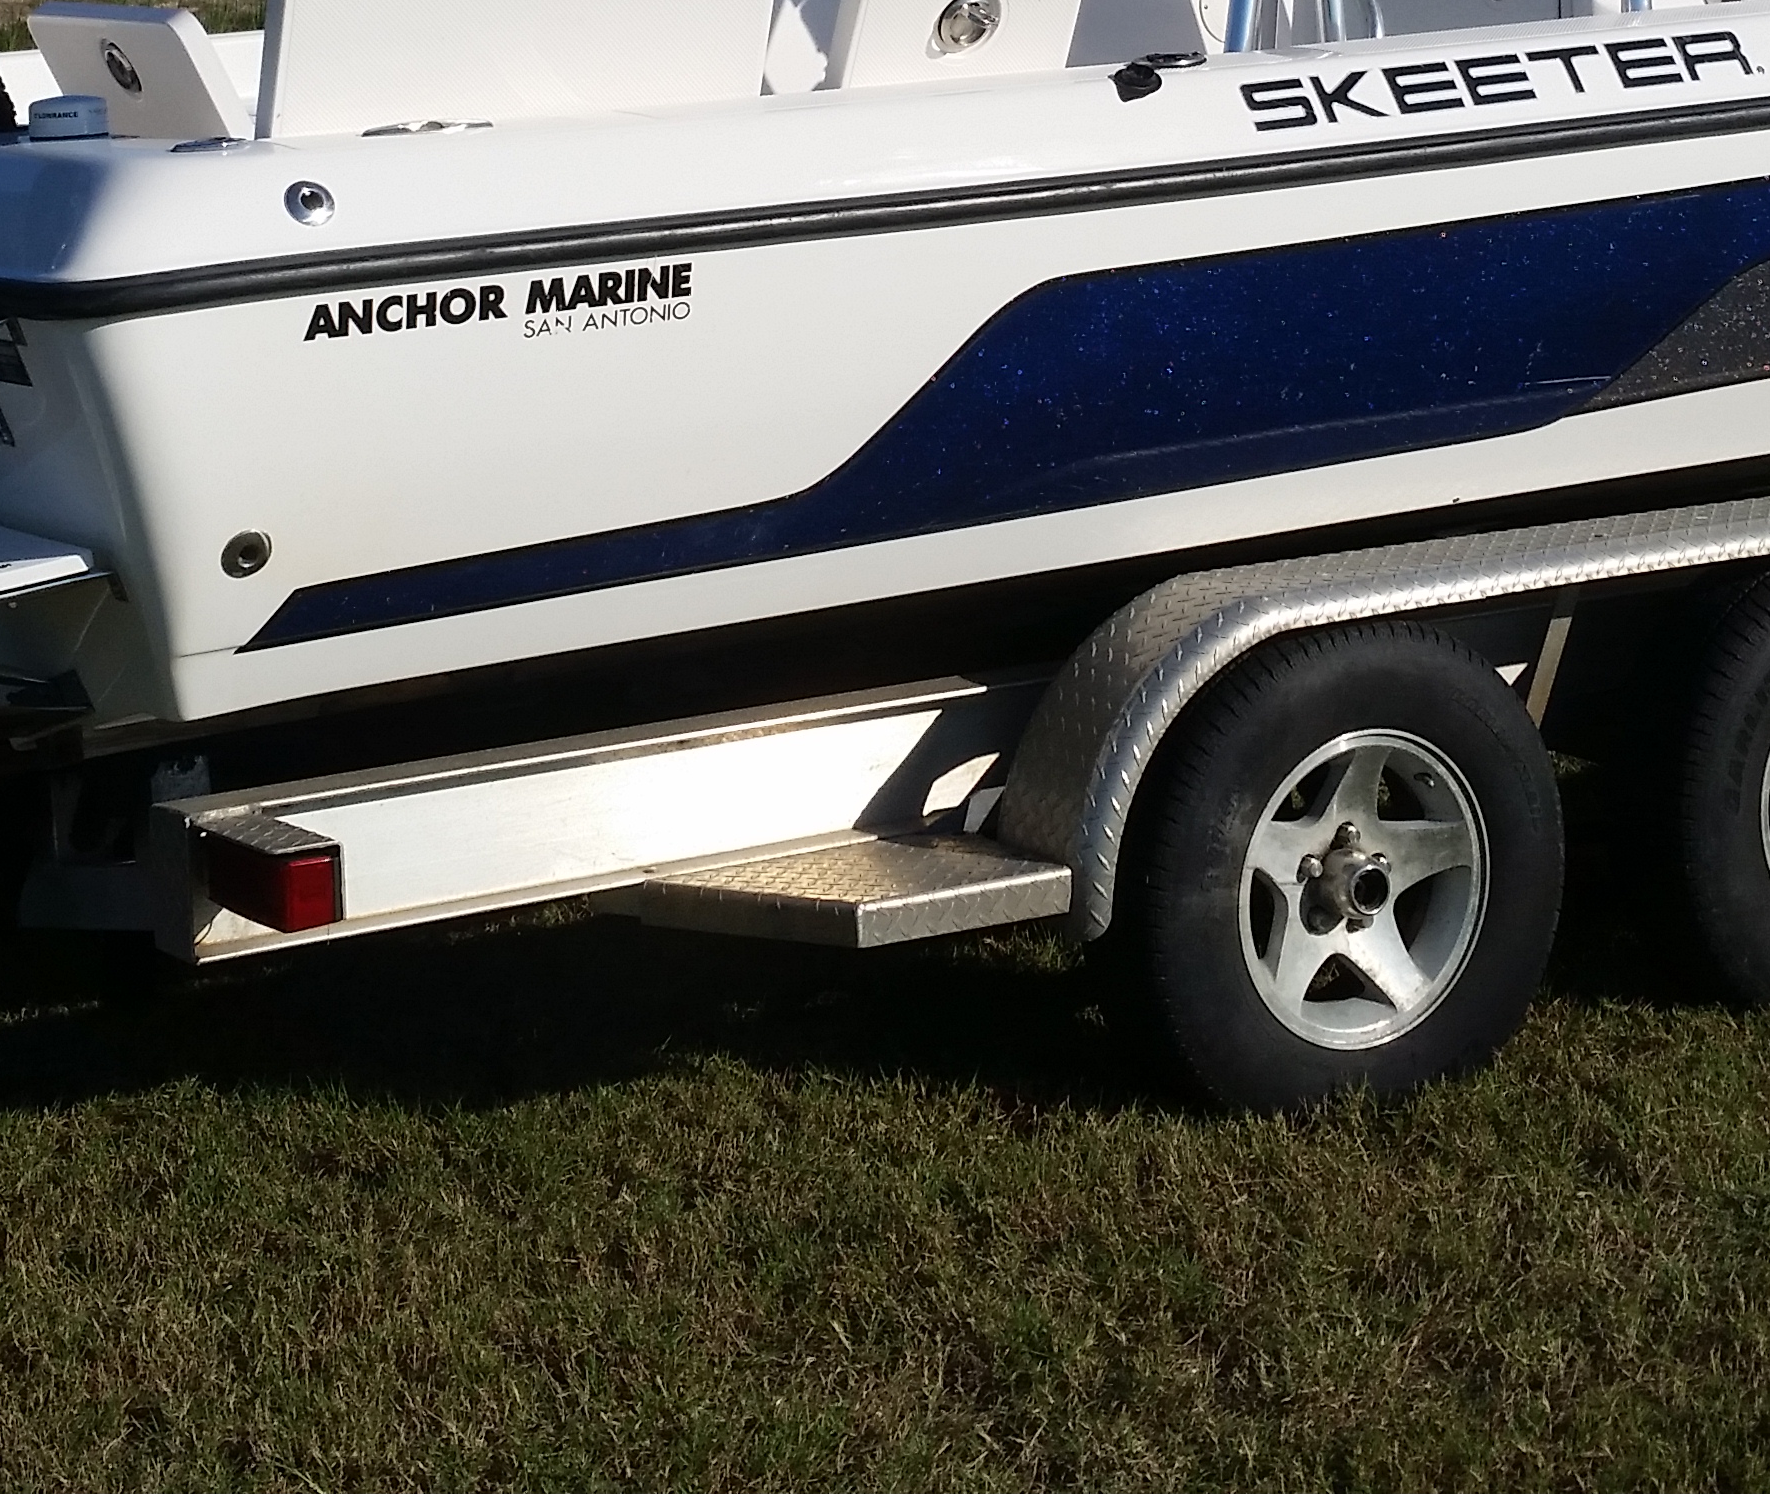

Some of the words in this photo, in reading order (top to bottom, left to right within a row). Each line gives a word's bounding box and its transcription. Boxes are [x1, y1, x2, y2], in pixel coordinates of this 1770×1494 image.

[1239, 31, 1753, 132] SKEETER
[303, 284, 508, 341] ANCHOR
[524, 262, 693, 314] MARINE
[523, 315, 573, 338] SAN
[583, 301, 691, 332] ANTONIO
